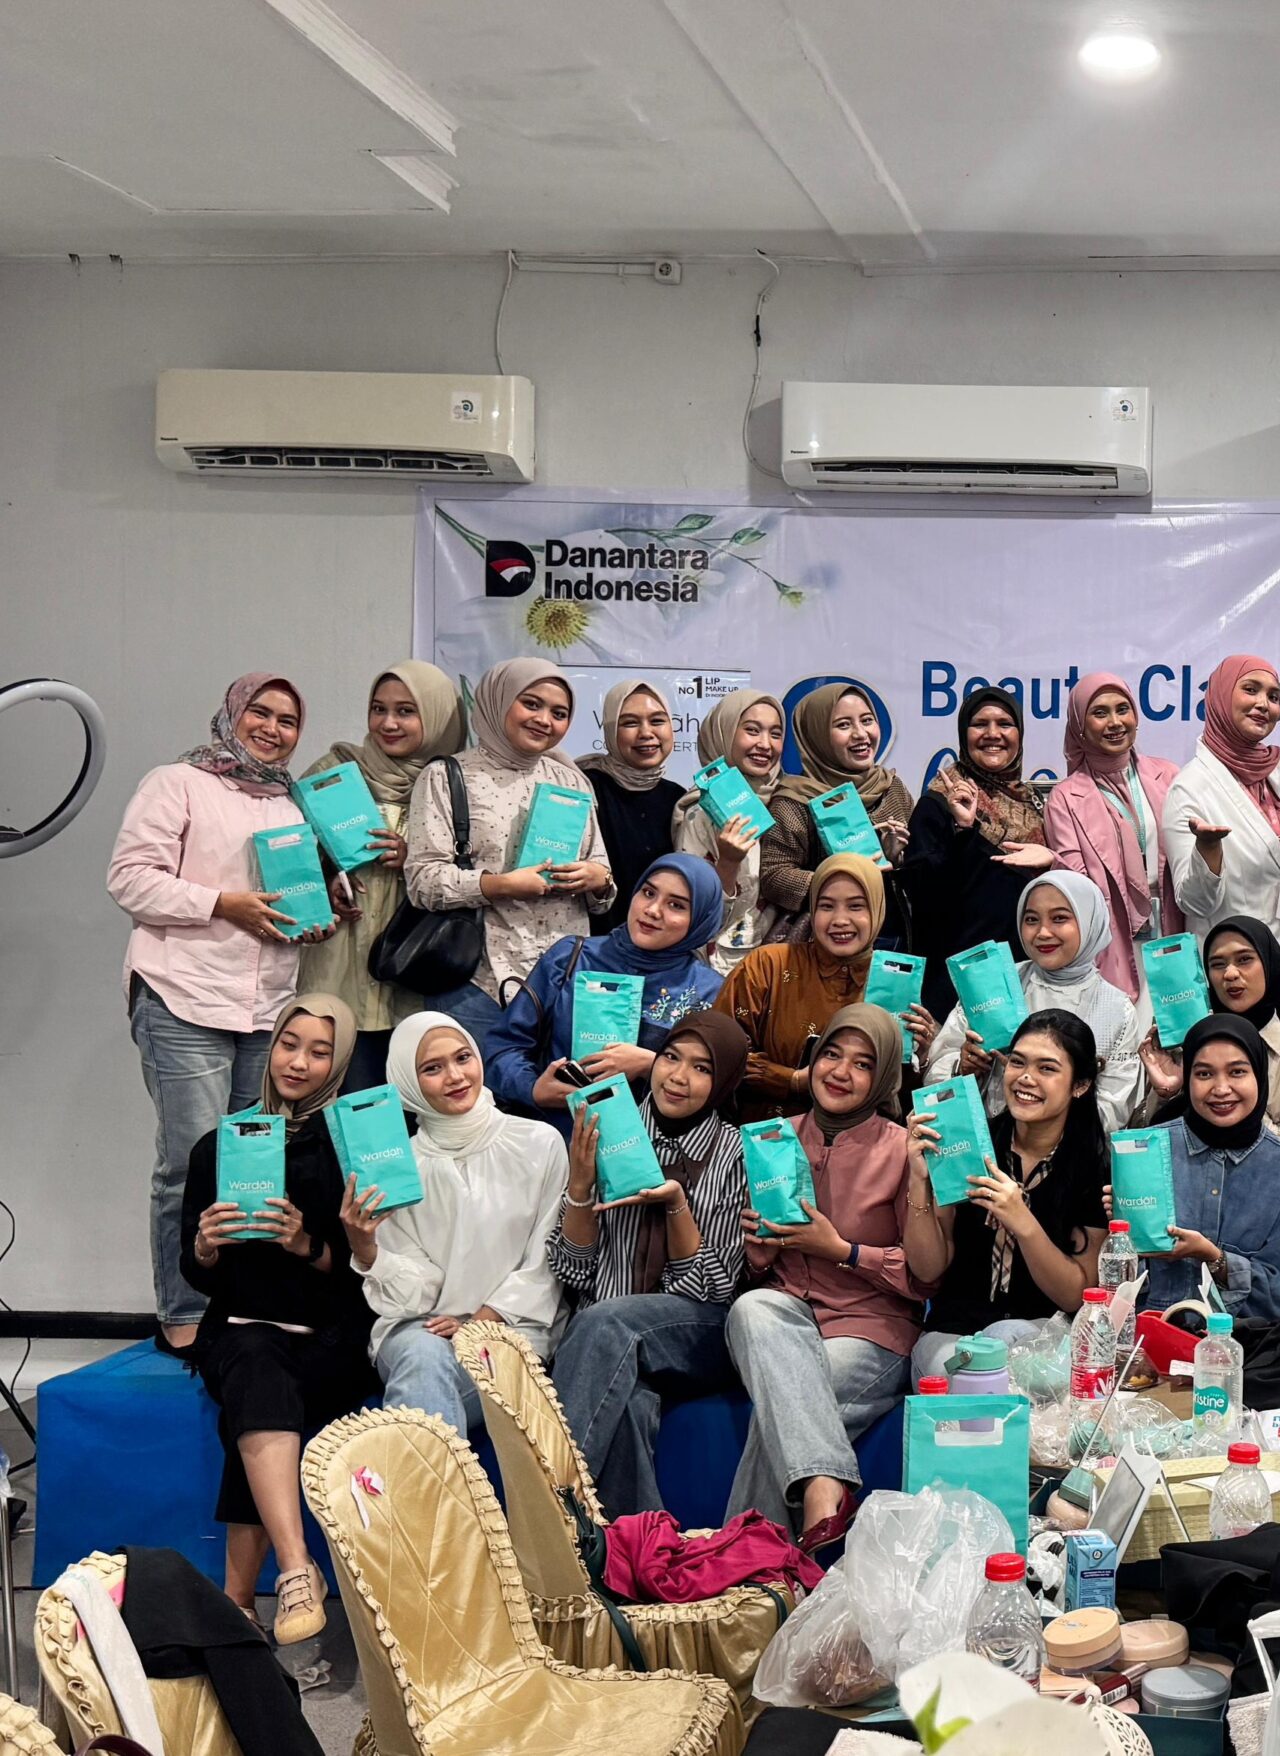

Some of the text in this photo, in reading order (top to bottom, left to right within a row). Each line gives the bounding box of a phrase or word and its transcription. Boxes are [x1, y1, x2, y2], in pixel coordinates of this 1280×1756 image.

[545, 539, 709, 570] Danantara
[544, 572, 699, 602] Indonesia
[678, 676, 702, 698] NO 1
[705, 677, 721, 685] LIP
[1194, 1392, 1225, 1408] ristine
